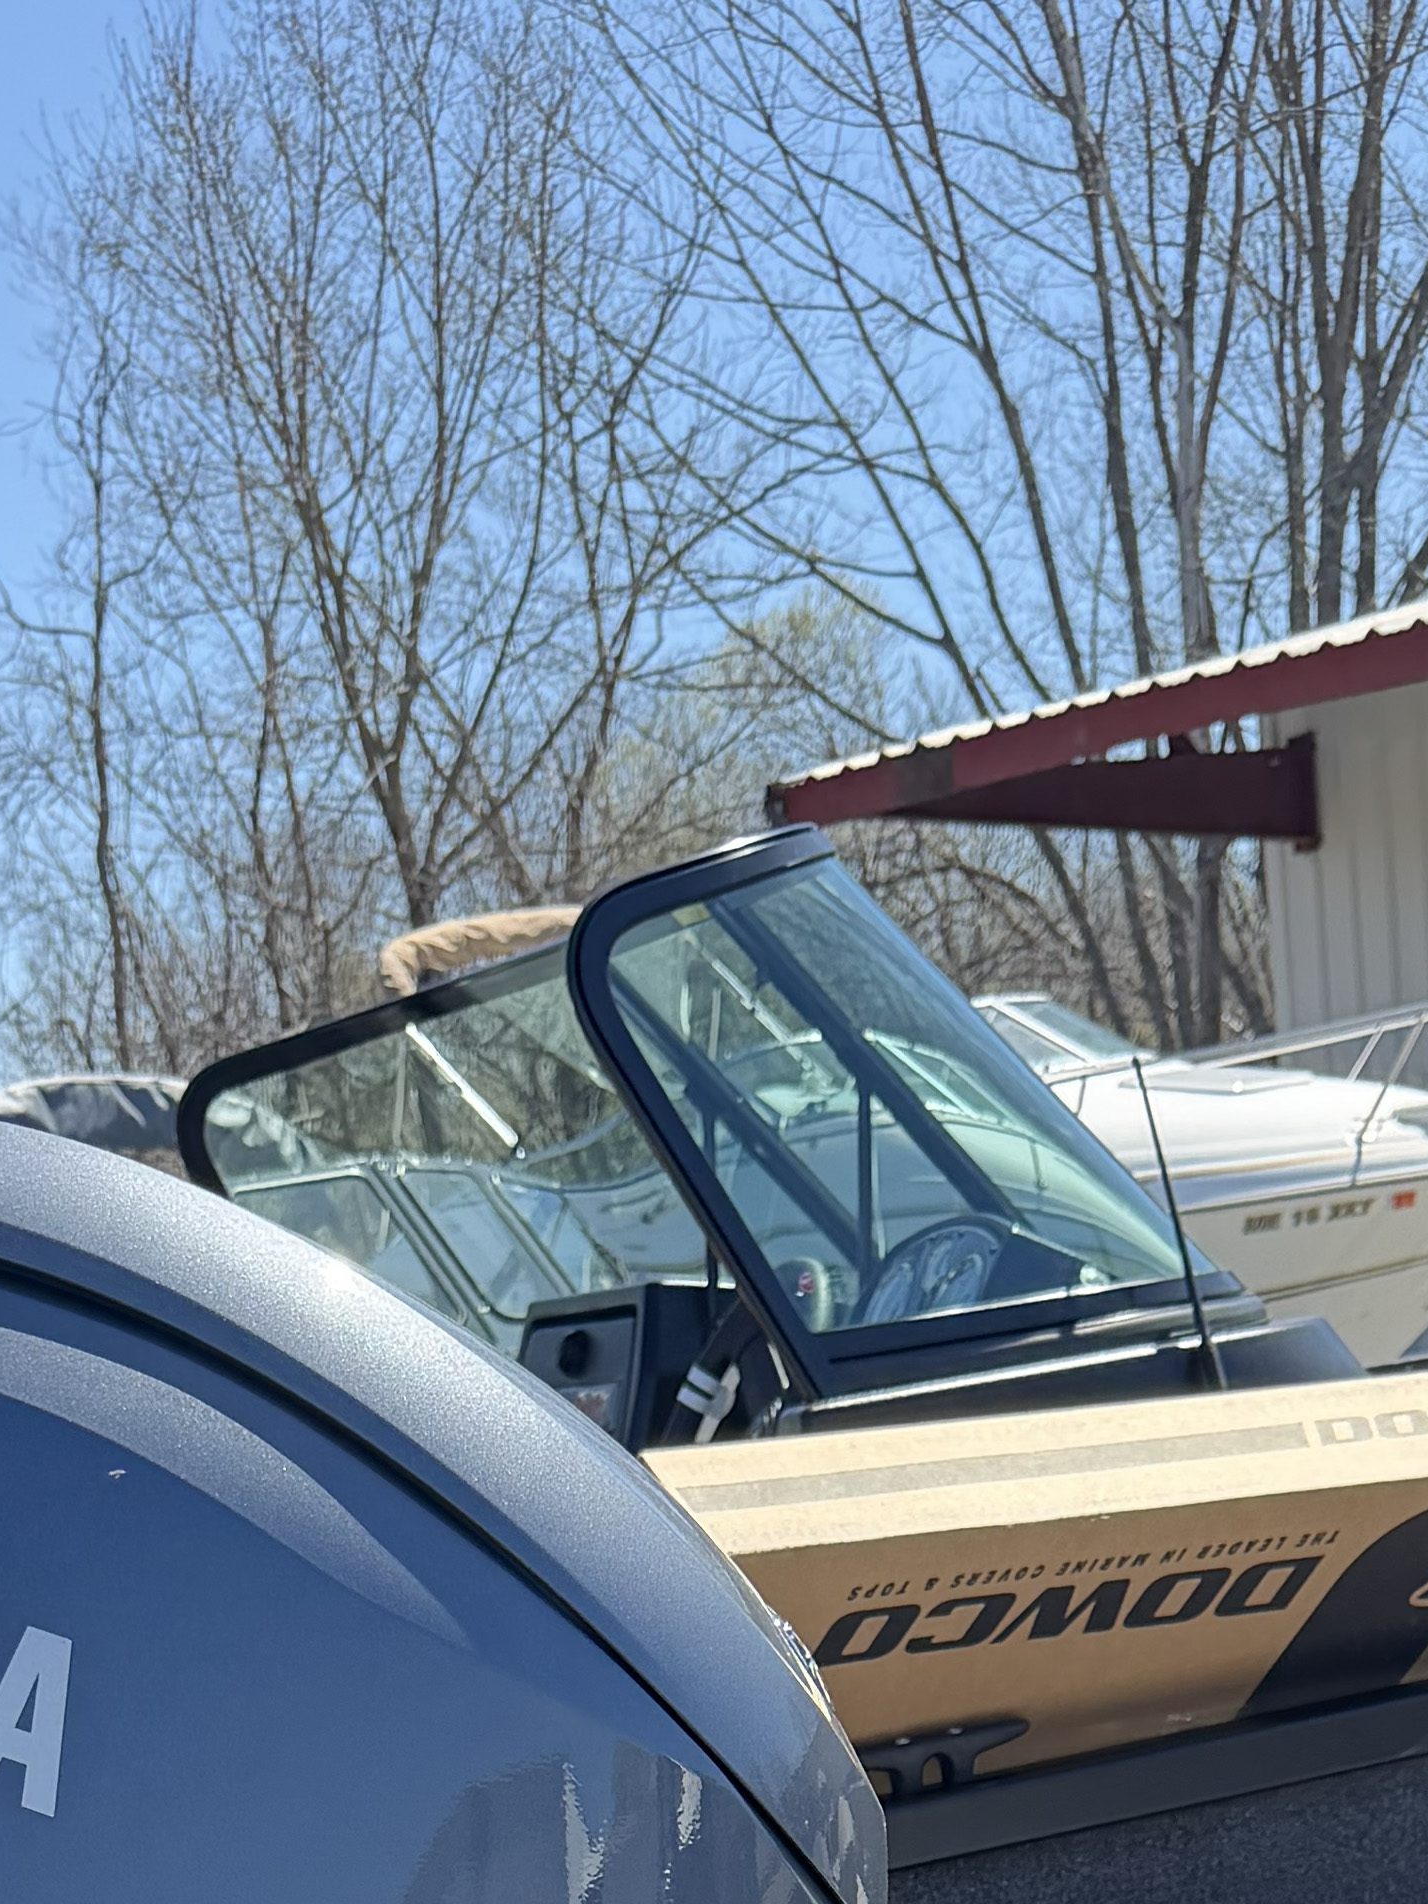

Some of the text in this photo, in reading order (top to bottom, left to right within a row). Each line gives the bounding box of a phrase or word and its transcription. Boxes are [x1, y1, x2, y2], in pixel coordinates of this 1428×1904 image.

[1196, 1536, 1288, 1560] LEADER
[1294, 1529, 1340, 1548] THE
[1055, 1552, 1151, 1576] MARINE
[1159, 1548, 1188, 1564] IN
[949, 1564, 1046, 1589] COVERS
[847, 1579, 911, 1602] TOPS
[812, 1554, 1325, 1668] DOWCO
